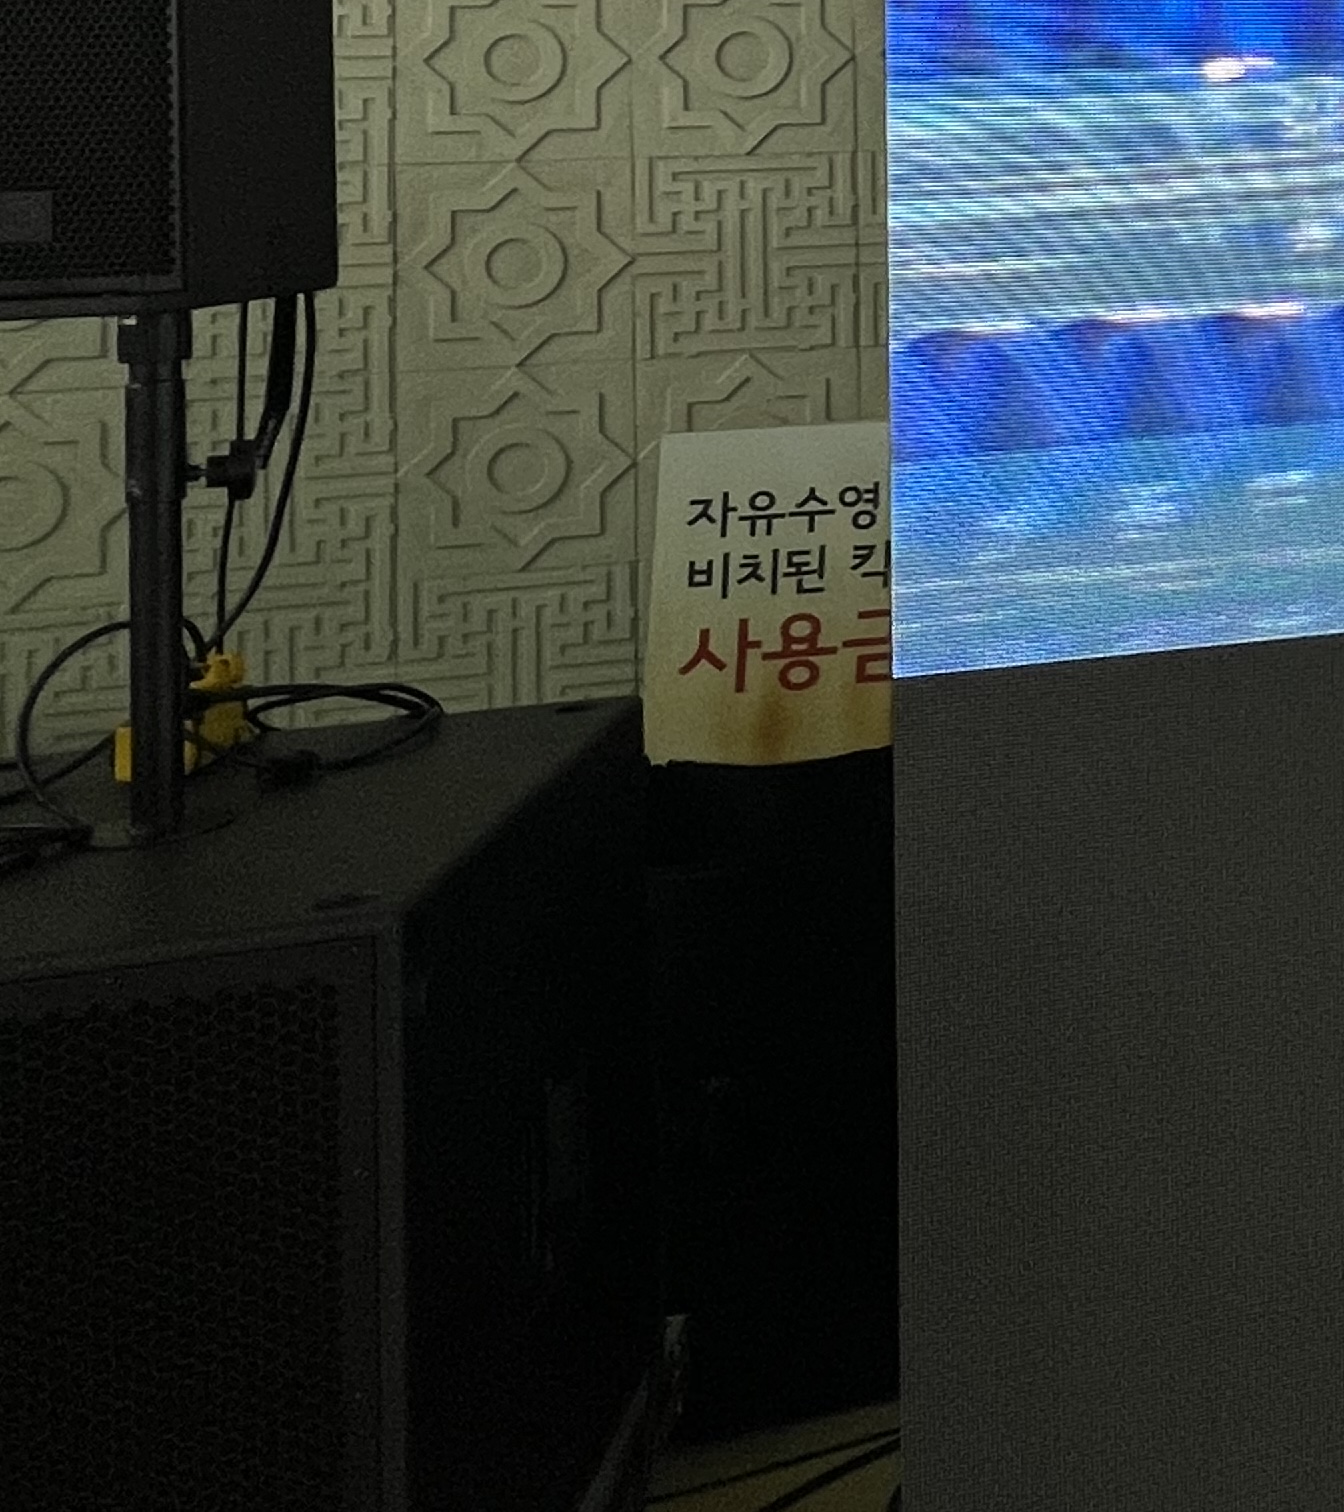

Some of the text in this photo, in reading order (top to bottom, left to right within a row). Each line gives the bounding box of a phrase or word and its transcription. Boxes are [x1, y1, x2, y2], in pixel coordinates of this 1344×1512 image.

[686, 481, 881, 538] 자유수영
[687, 540, 891, 599] 비치된 킥
